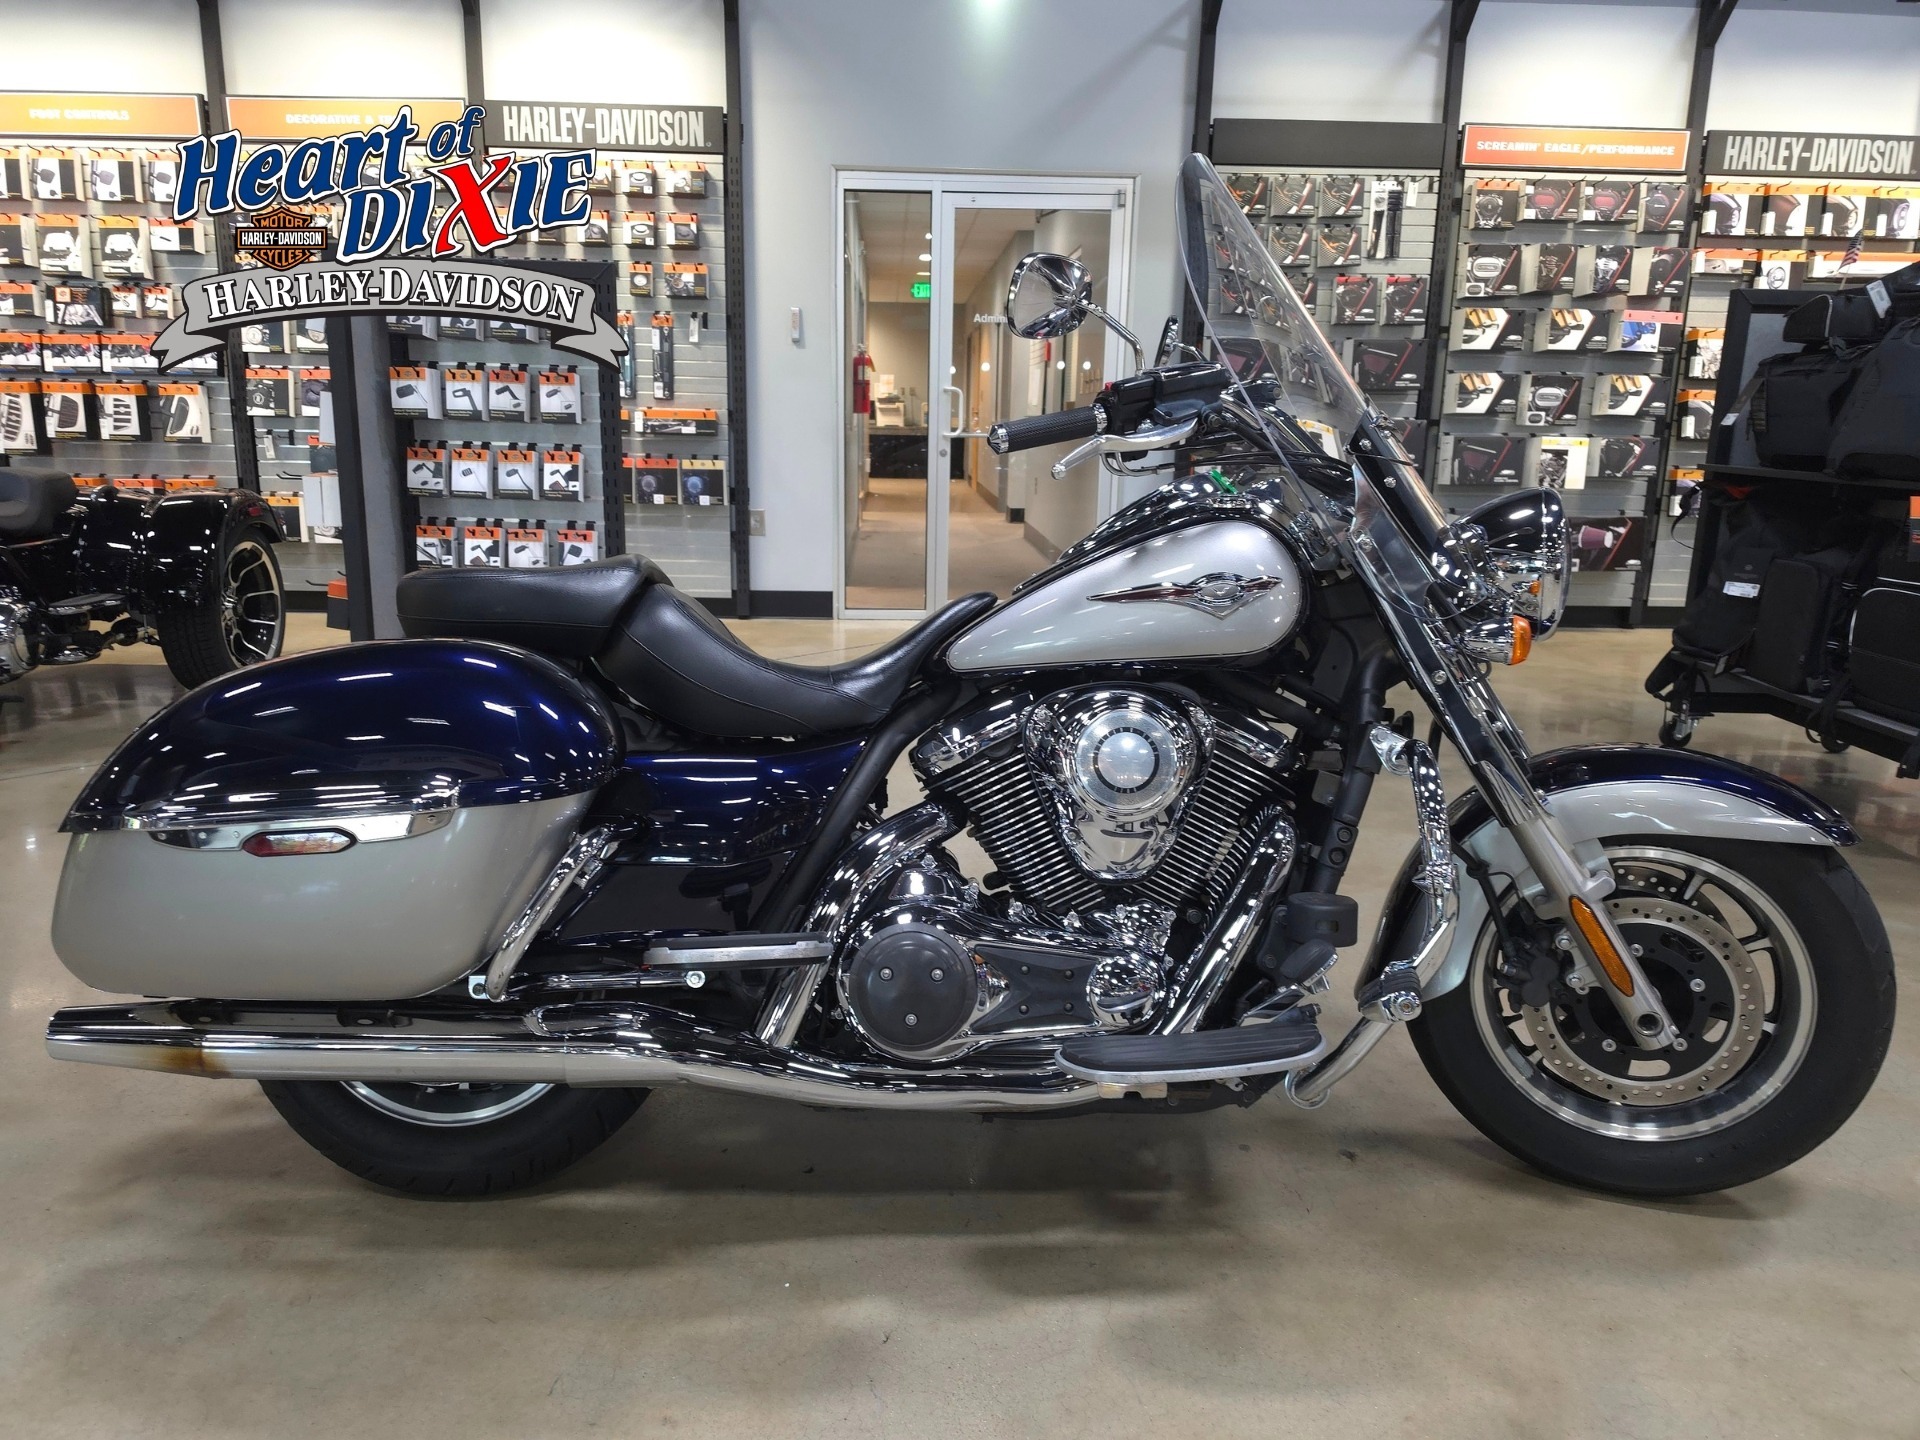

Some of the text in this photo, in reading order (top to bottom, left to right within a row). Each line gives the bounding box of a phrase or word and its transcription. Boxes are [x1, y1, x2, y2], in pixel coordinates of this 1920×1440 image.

[285, 113, 361, 124] DECORATIVE
[502, 105, 704, 147] HARLEY-DAVIDSON
[1722, 135, 1915, 175] HARLEY-DAVIDSON
